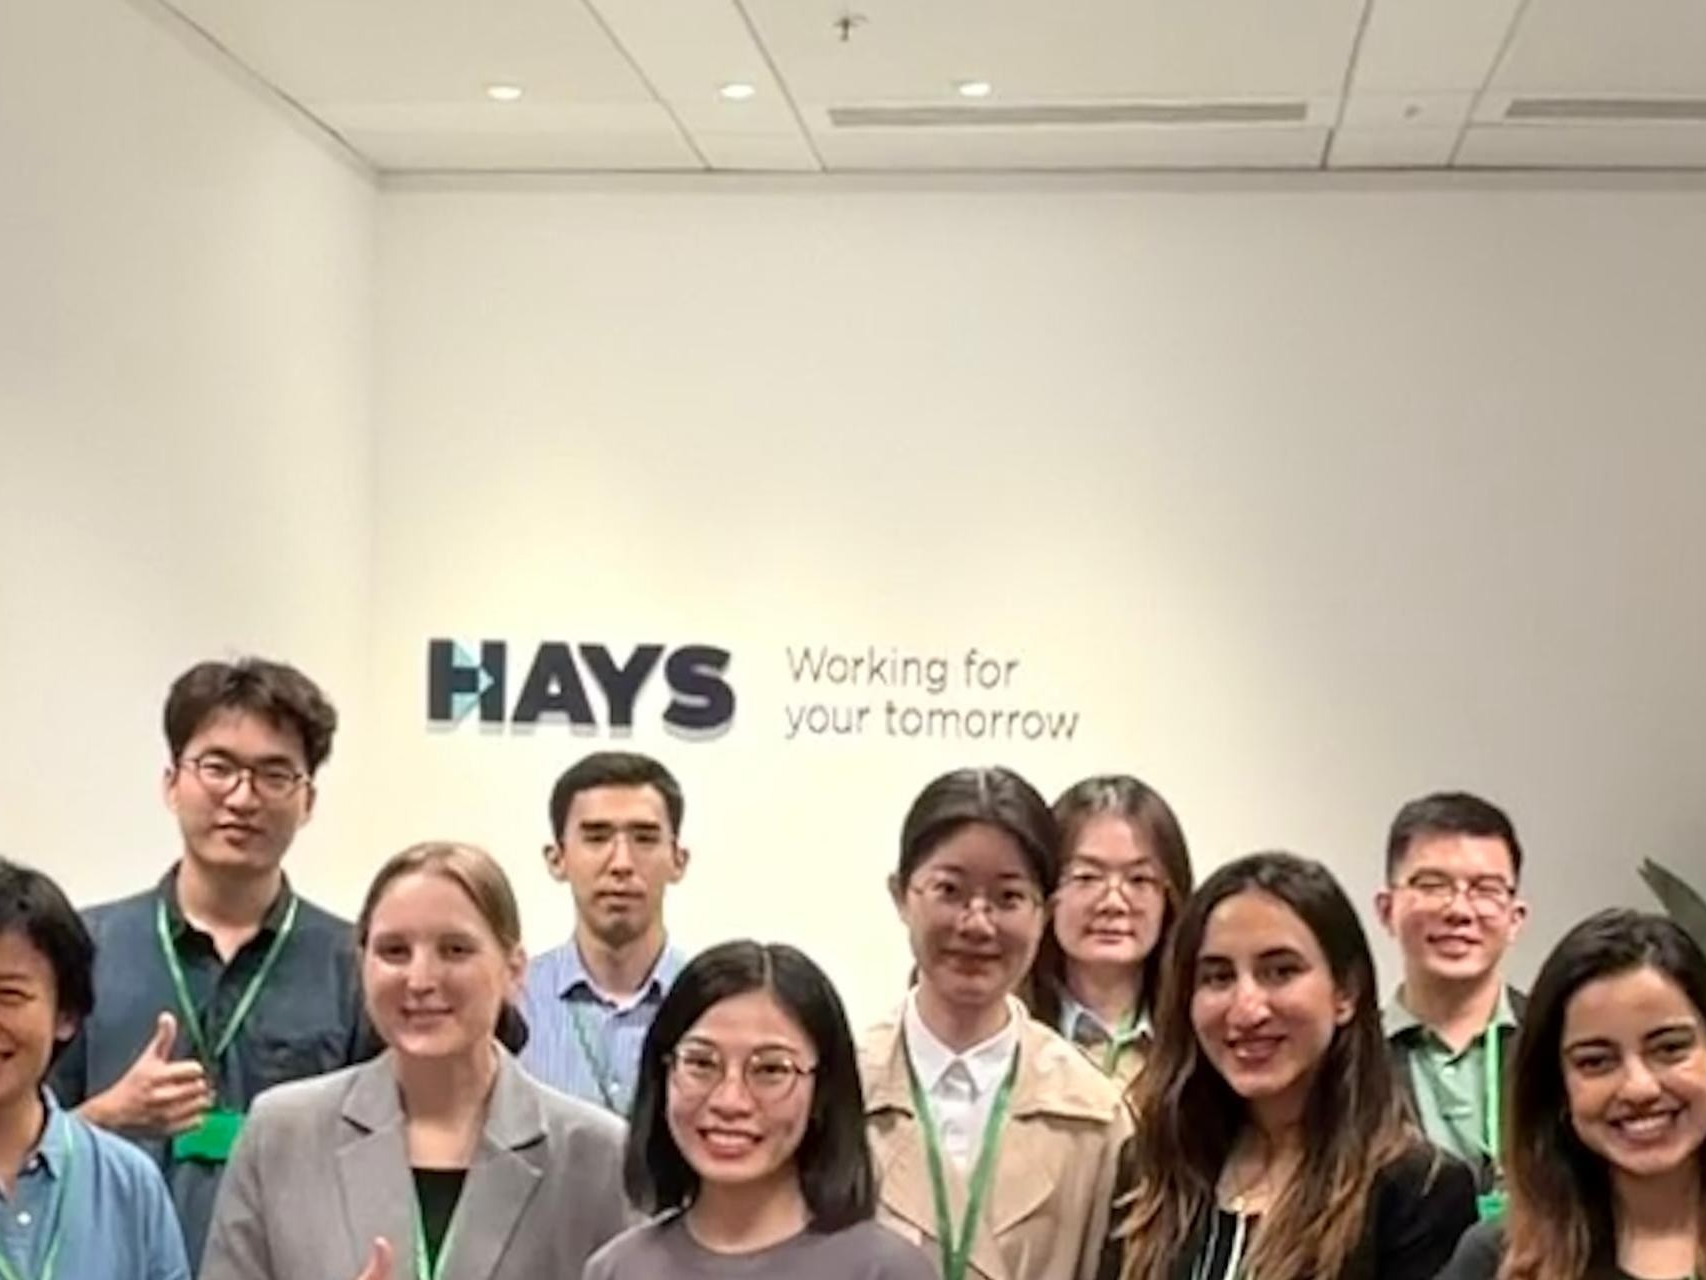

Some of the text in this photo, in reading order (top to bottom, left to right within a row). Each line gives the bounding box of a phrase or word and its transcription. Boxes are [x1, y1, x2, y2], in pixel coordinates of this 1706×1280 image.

[427, 637, 737, 734] HAYS
[784, 646, 1020, 696] Working for
[784, 705, 1080, 742] your tomorrow
